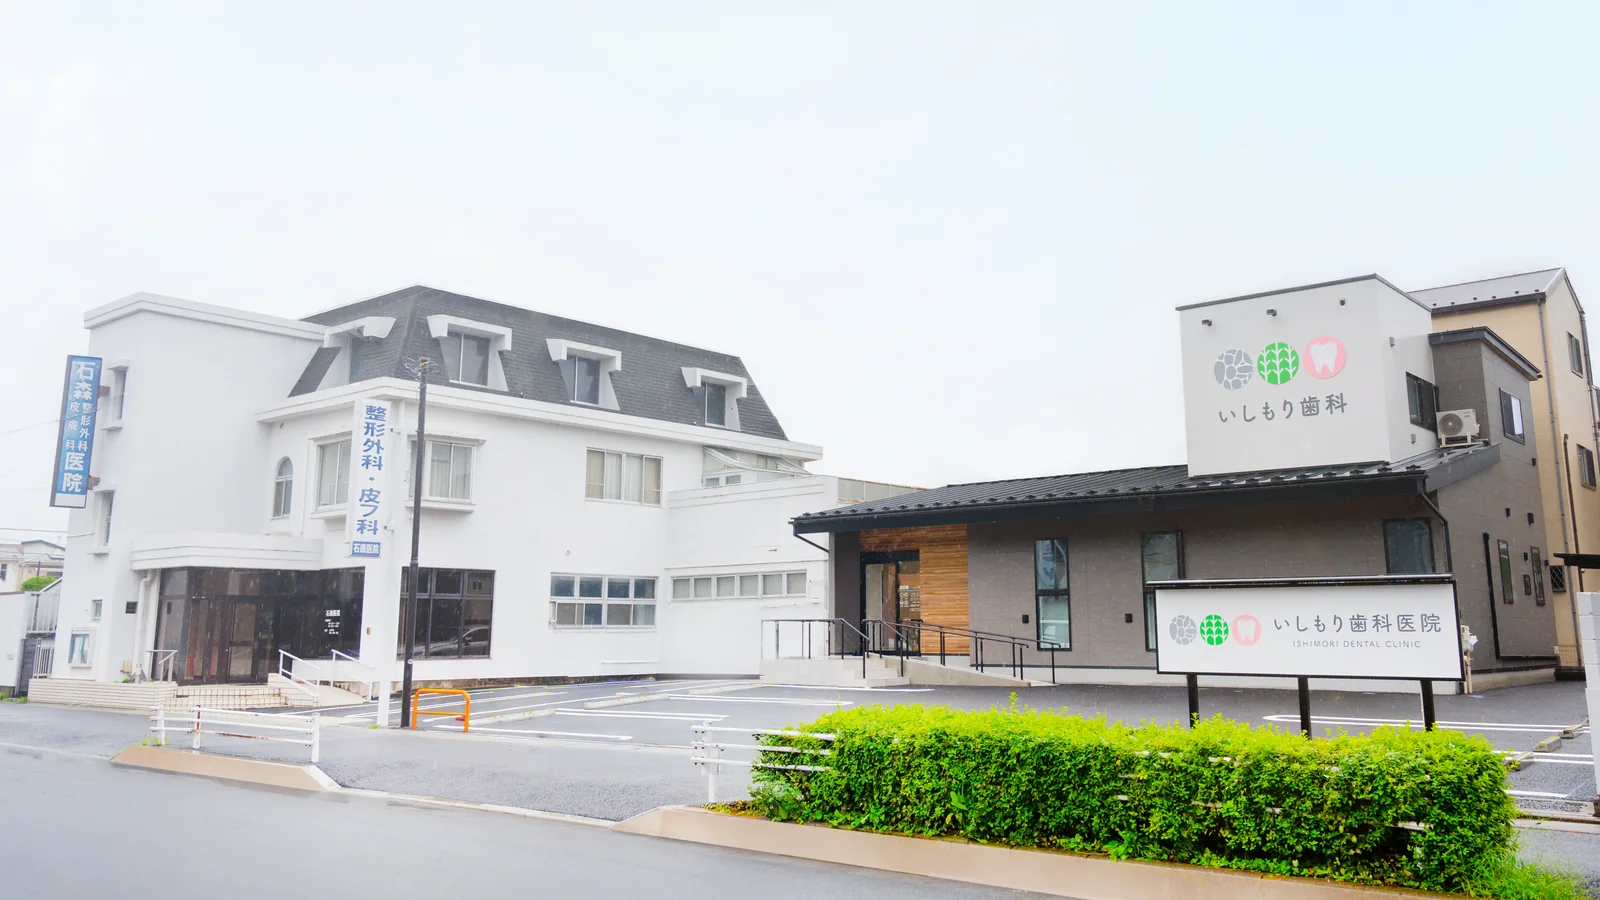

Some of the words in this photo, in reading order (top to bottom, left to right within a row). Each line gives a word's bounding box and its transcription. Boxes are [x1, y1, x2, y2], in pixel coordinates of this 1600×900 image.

[72, 361, 96, 400] 石森
[78, 402, 93, 452] 整形外科
[1218, 392, 1348, 423] いしもり歯科
[61, 451, 85, 493] 医院
[356, 405, 387, 535] 整形外科・皮フ科
[1273, 613, 1442, 633] いしもり歯科医院
[1293, 640, 1339, 648] ISHIMORI
[1343, 640, 1381, 648] DENTAL
[1385, 640, 1421, 648] CLINIC
